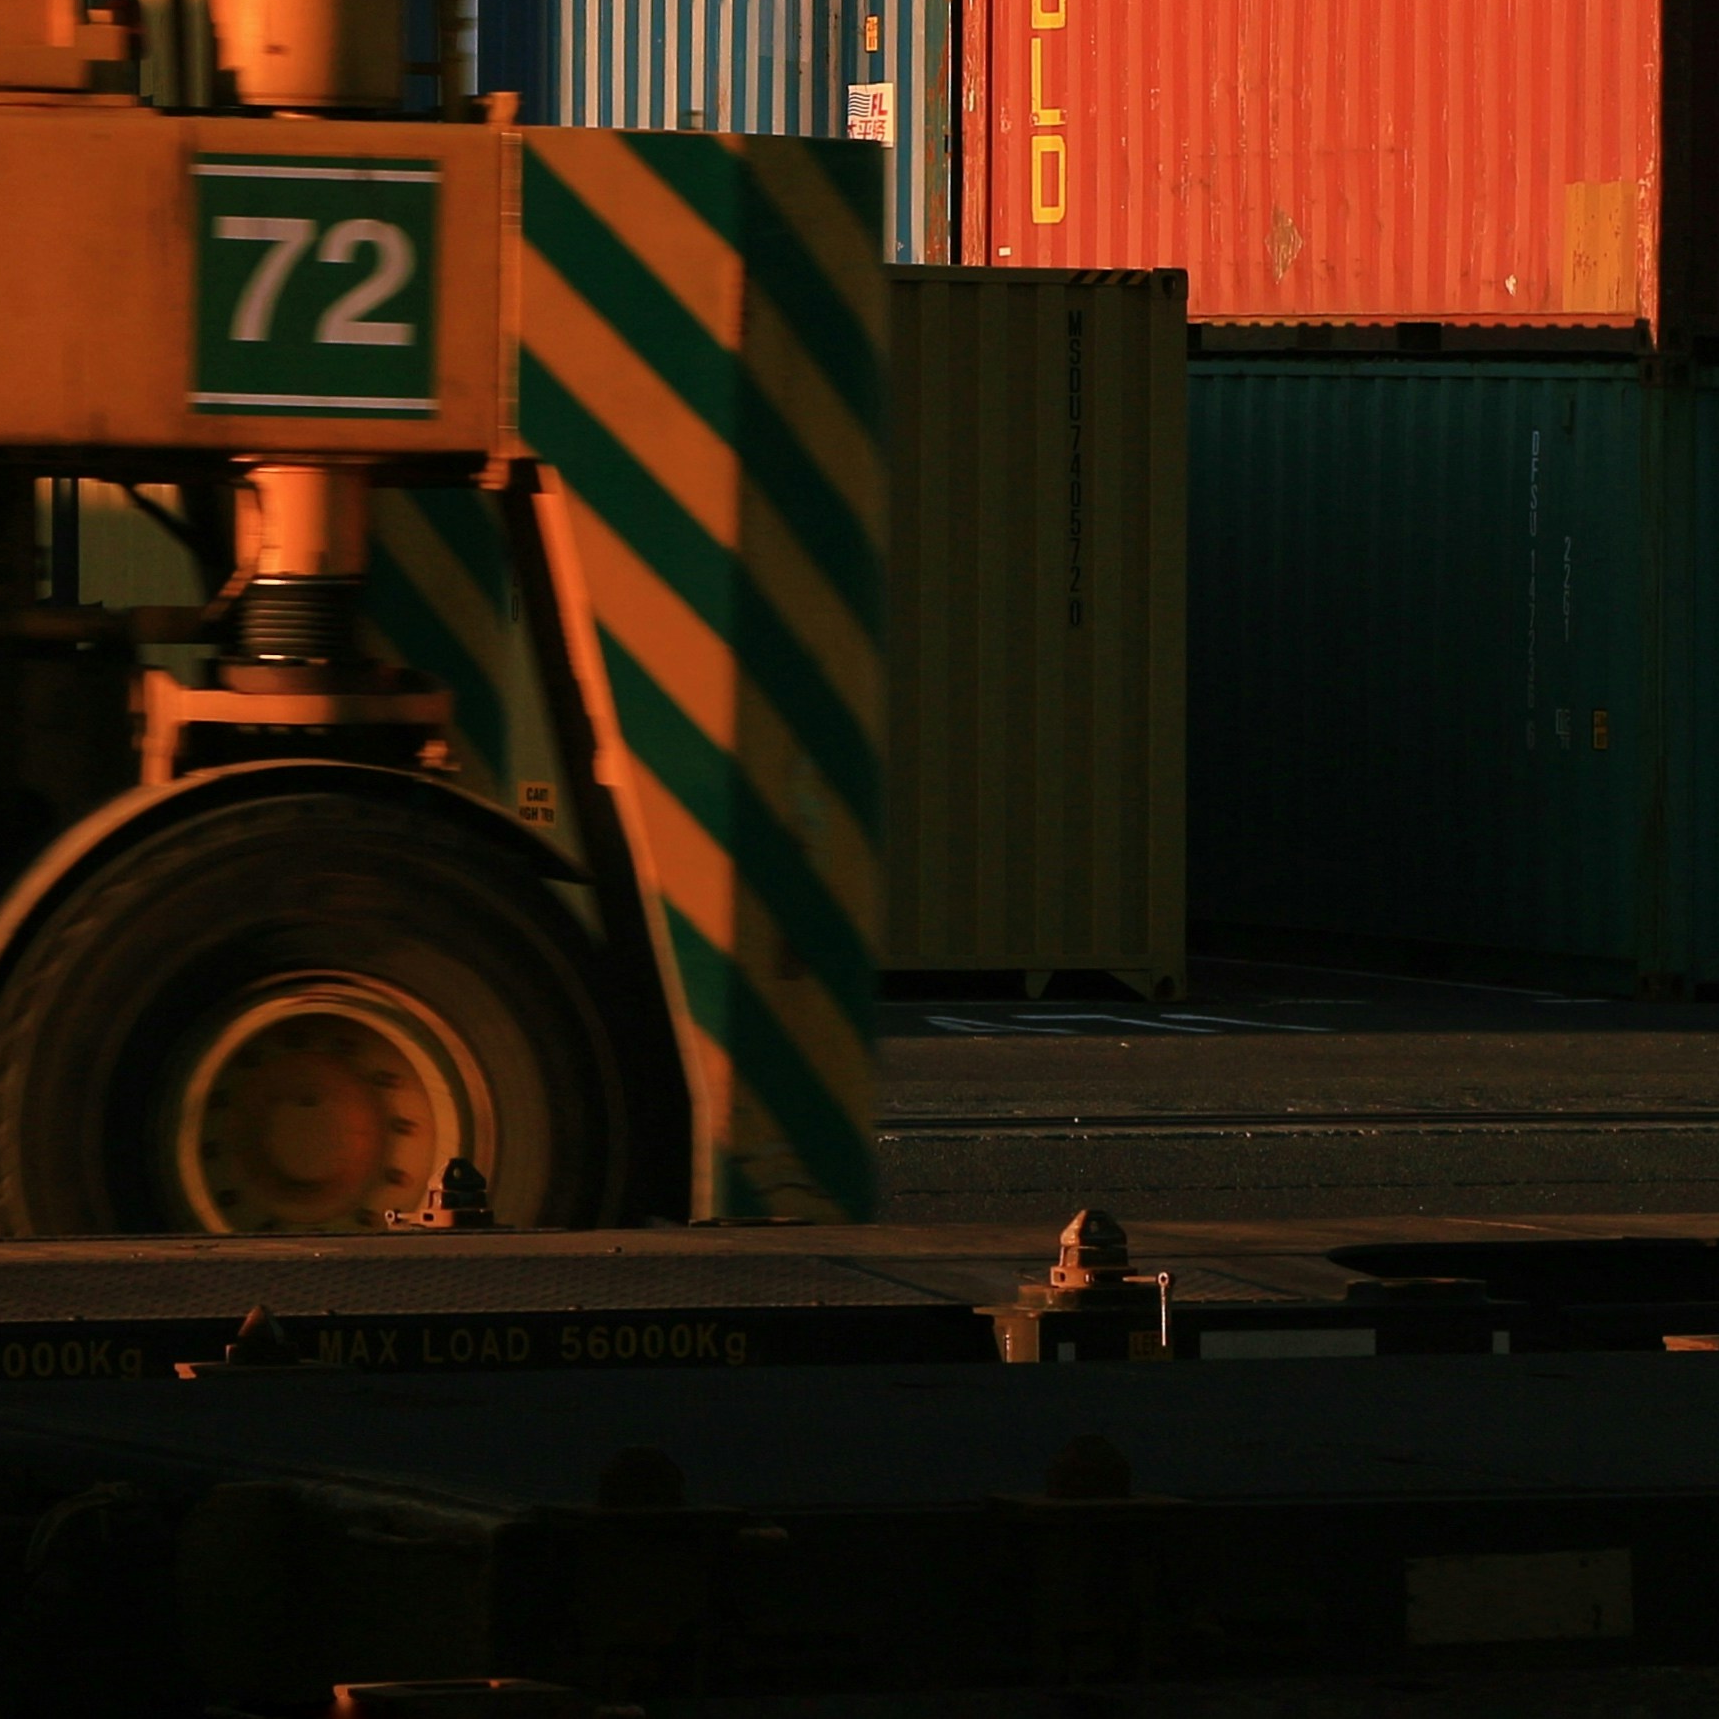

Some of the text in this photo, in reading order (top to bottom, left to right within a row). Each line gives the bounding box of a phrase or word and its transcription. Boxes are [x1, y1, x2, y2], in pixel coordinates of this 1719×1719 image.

[212, 215, 419, 348] 72
[1068, 310, 1082, 627] MSDU 740572 0
[1529, 430, 1541, 538] DFSU
[1563, 536, 1571, 643] 22G1
[317, 1321, 748, 1366] MAX LOAD 56000Kg
[1133, 1333, 1166, 1357] LEF
